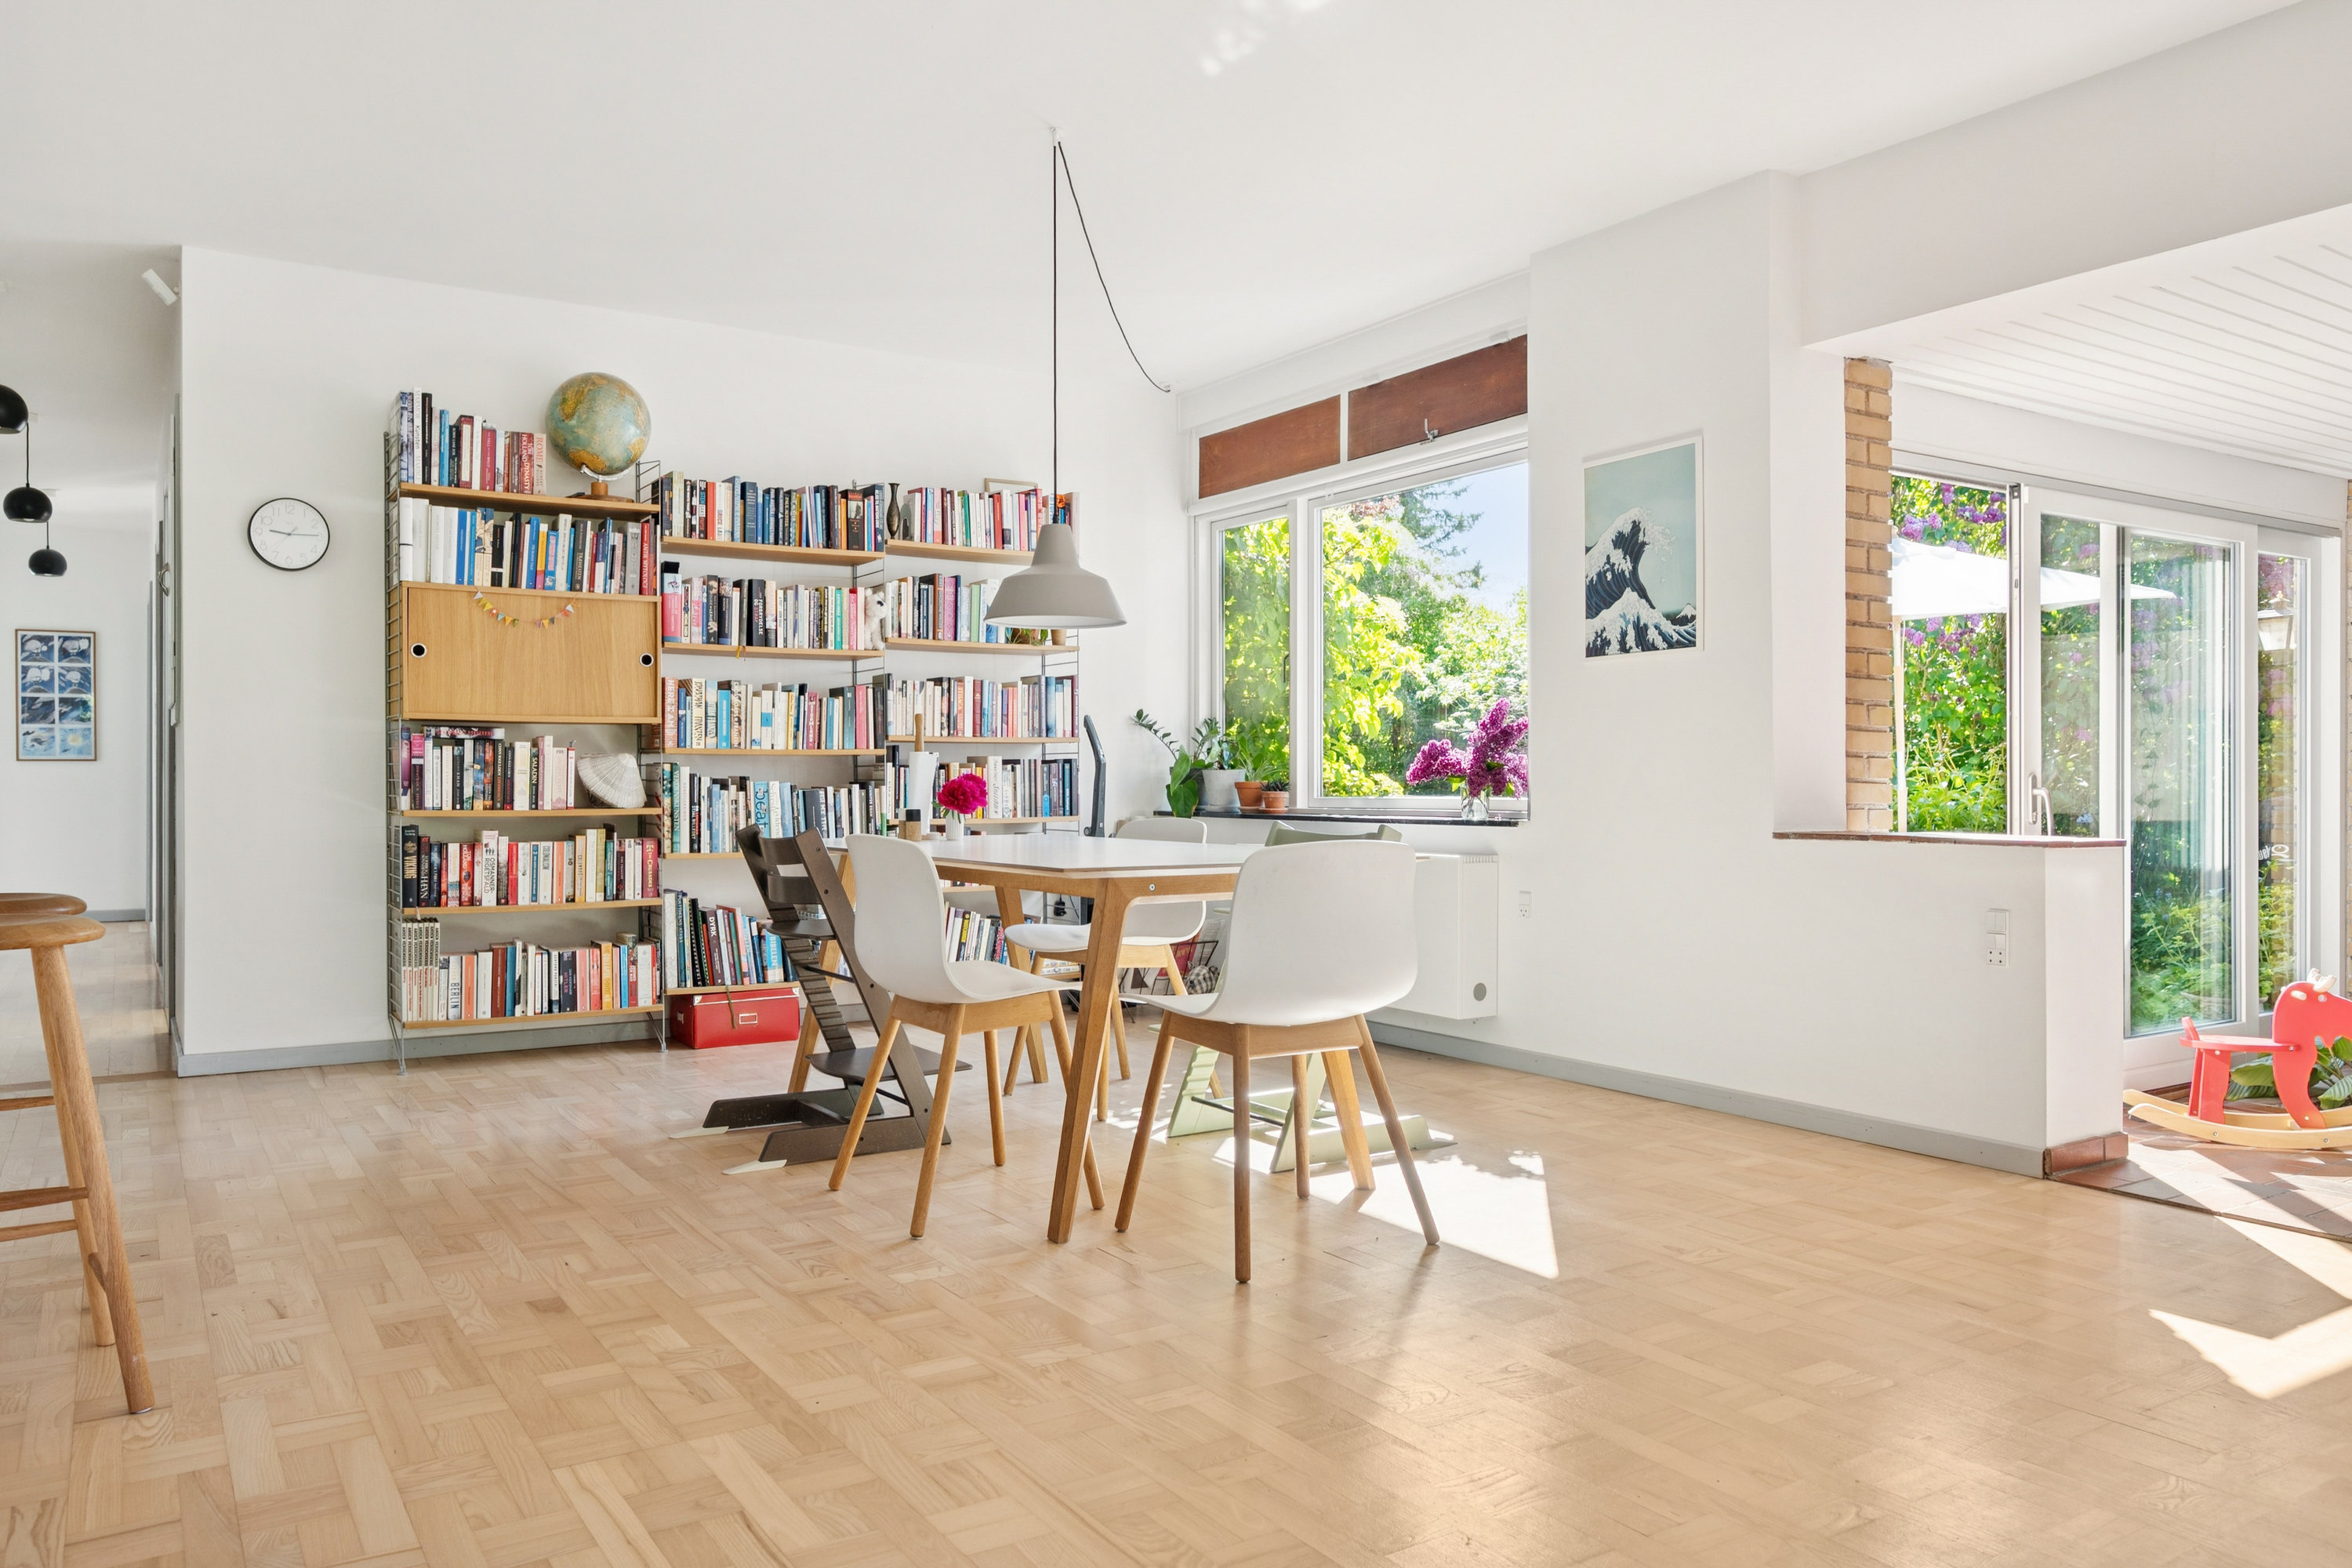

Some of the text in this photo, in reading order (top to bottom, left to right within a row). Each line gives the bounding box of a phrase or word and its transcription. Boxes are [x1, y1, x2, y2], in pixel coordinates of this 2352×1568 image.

[273, 507, 280, 516] 11
[285, 504, 295, 514] 12
[303, 509, 306, 517] 1
[261, 515, 274, 525] 10
[311, 519, 319, 528] 2
[255, 527, 263, 536] 9
[260, 540, 267, 550] 8
[310, 545, 318, 554] 4
[272, 550, 279, 560] 7
[285, 555, 293, 564] 6
[299, 554, 307, 563] 5
[667, 713, 675, 728] AM
[755, 789, 769, 828] beat
[542, 845, 551, 869] COLONIALISM
[404, 855, 417, 879] VIKING
[769, 936, 778, 966] BIBELEN
[451, 982, 459, 1009] BERLIN
